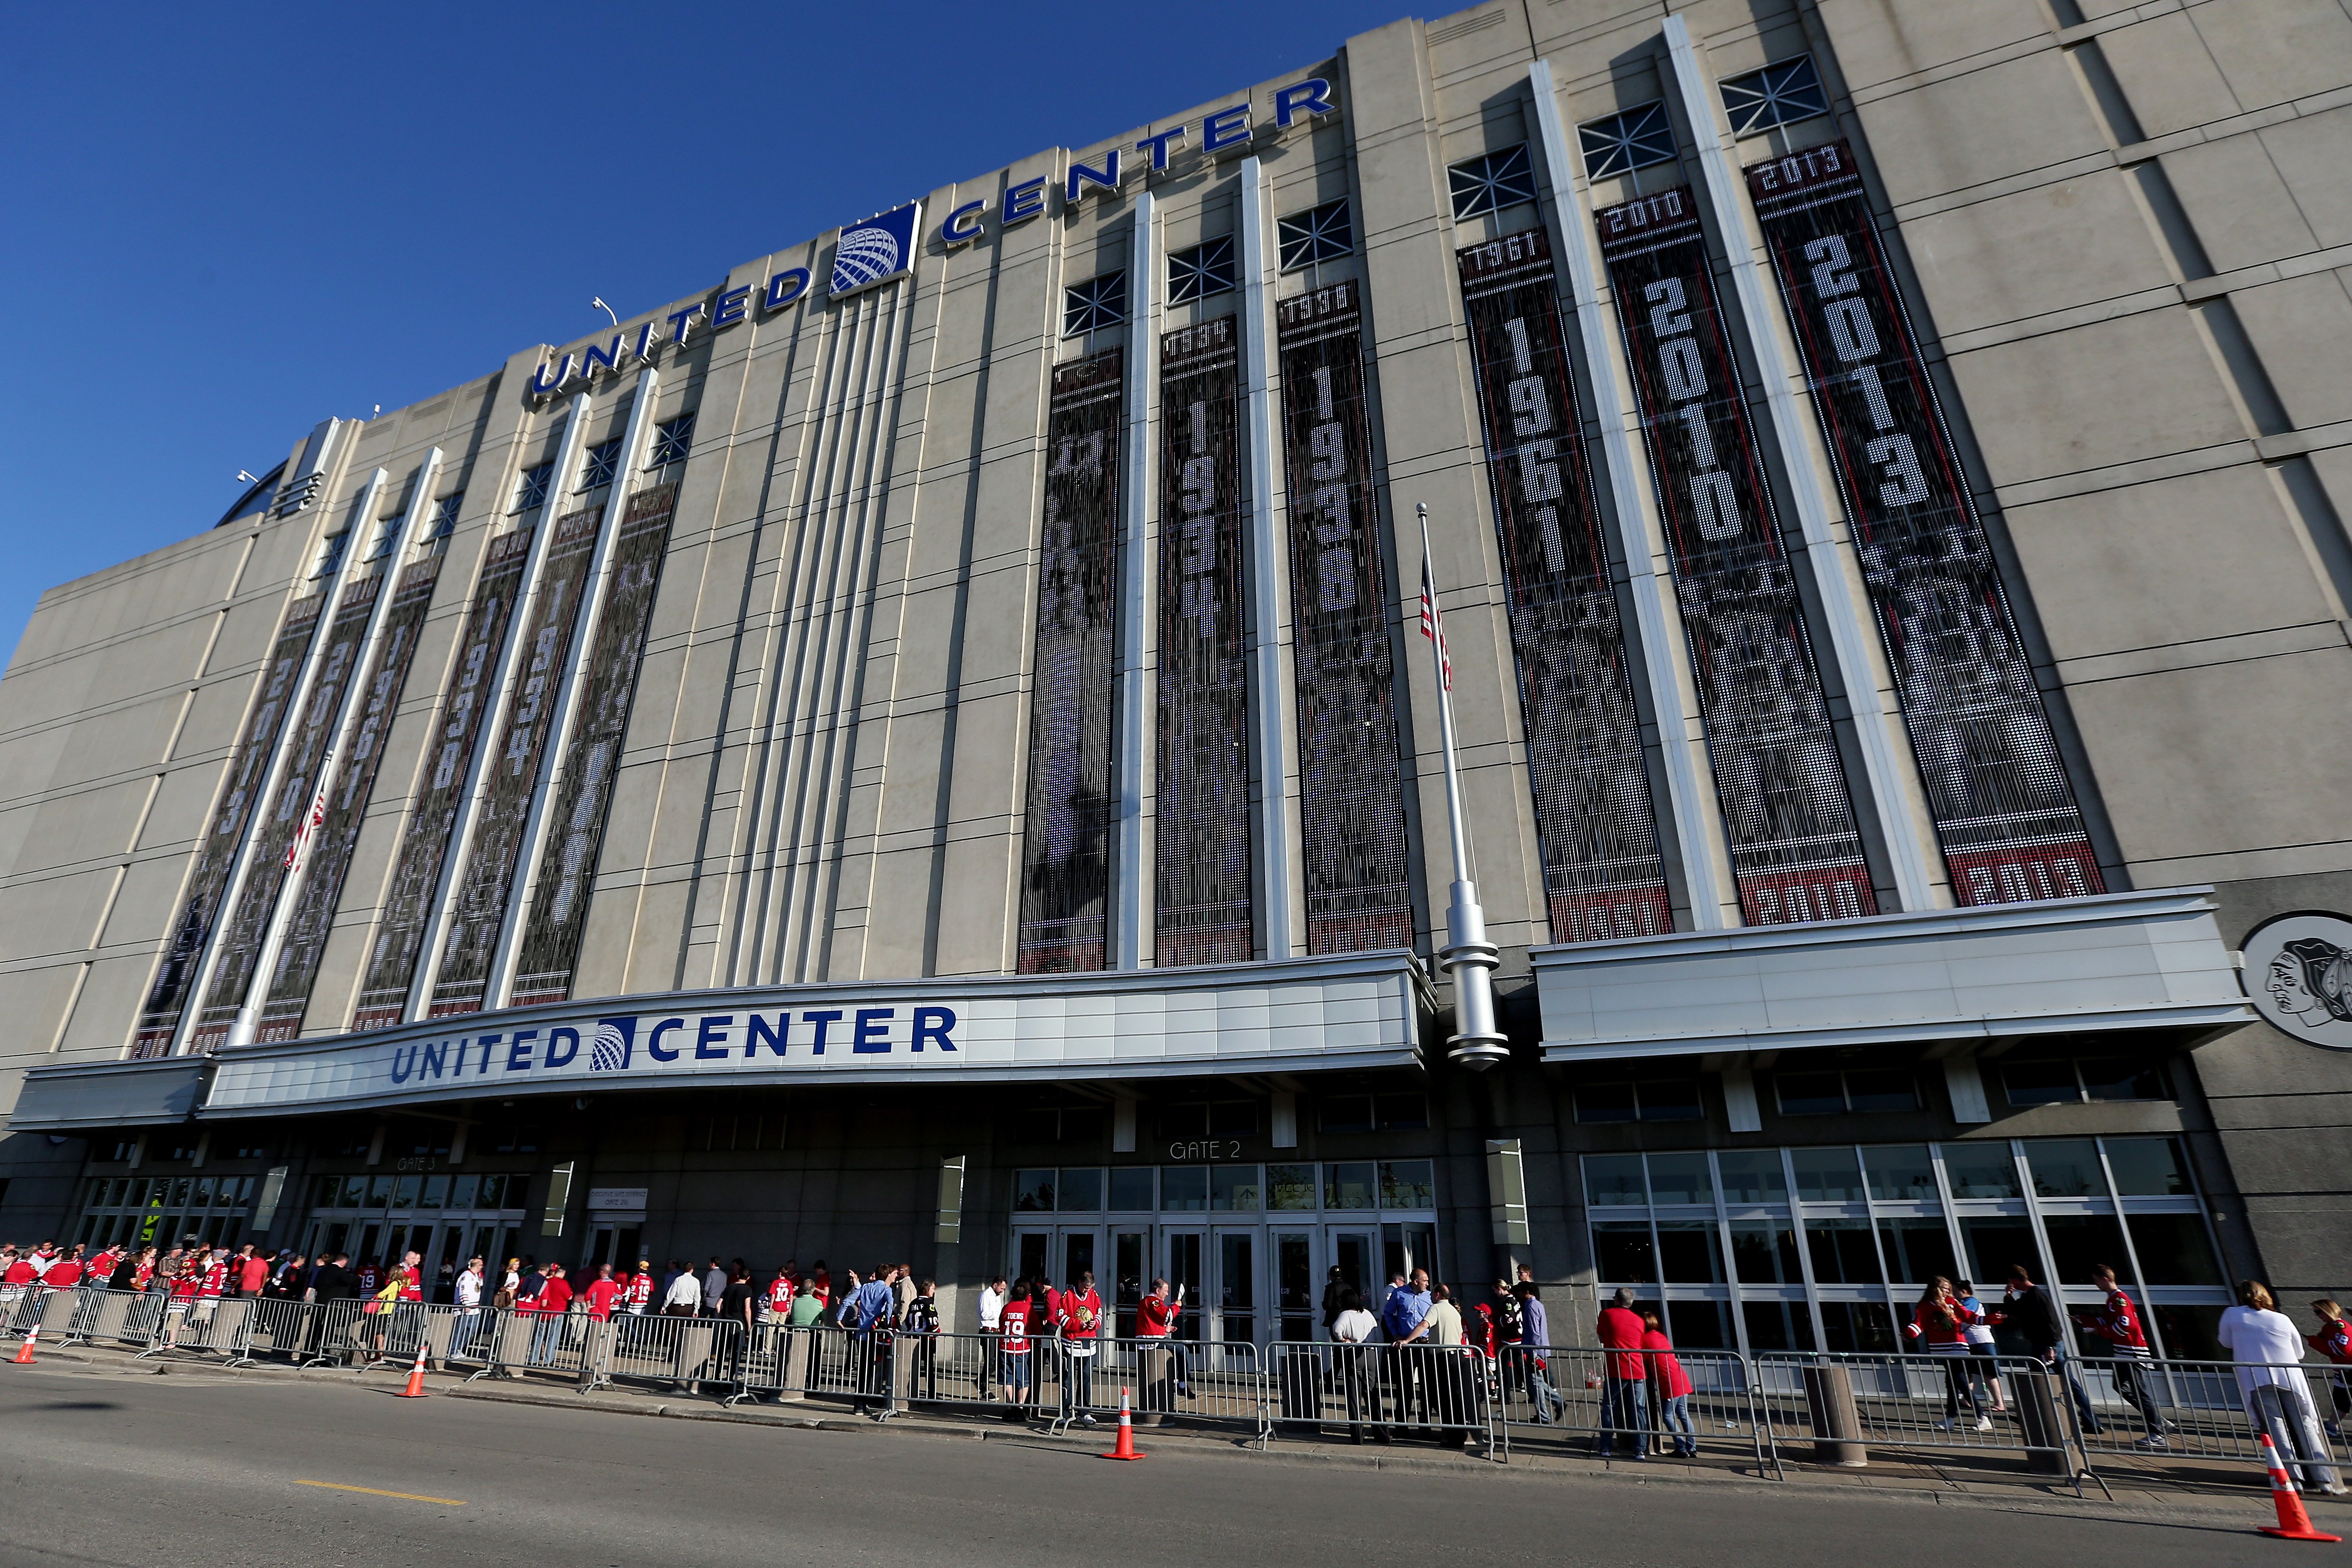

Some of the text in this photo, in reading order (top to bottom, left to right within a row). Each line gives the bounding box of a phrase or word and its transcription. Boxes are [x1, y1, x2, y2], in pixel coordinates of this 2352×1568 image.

[1762, 145, 1842, 190] 2013
[532, 77, 1337, 396] UNITED CENTER
[1473, 231, 1536, 270] 1961
[1609, 191, 1682, 233] 2010
[1645, 277, 1744, 542] 2010
[1804, 234, 1929, 508] 2013
[1504, 316, 1565, 573] 1961
[1182, 400, 1222, 638] 1934
[1310, 366, 1356, 612] 1938
[433, 597, 497, 790] 1938
[507, 579, 566, 776] 1934
[219, 658, 293, 834] 2013
[277, 641, 350, 821] 2010
[341, 625, 406, 810] 1961
[1967, 858, 2088, 907] 2013
[391, 1006, 958, 1084] UNITED CENTER
[398, 1157, 434, 1170] GATE 3
[1170, 1141, 1240, 1159] GATE 2
[361, 1275, 375, 1288] 19
[638, 1285, 650, 1301] 19
[775, 1287, 789, 1301] 10
[909, 1312, 927, 1332] 10
[1004, 1321, 1025, 1343] 19
